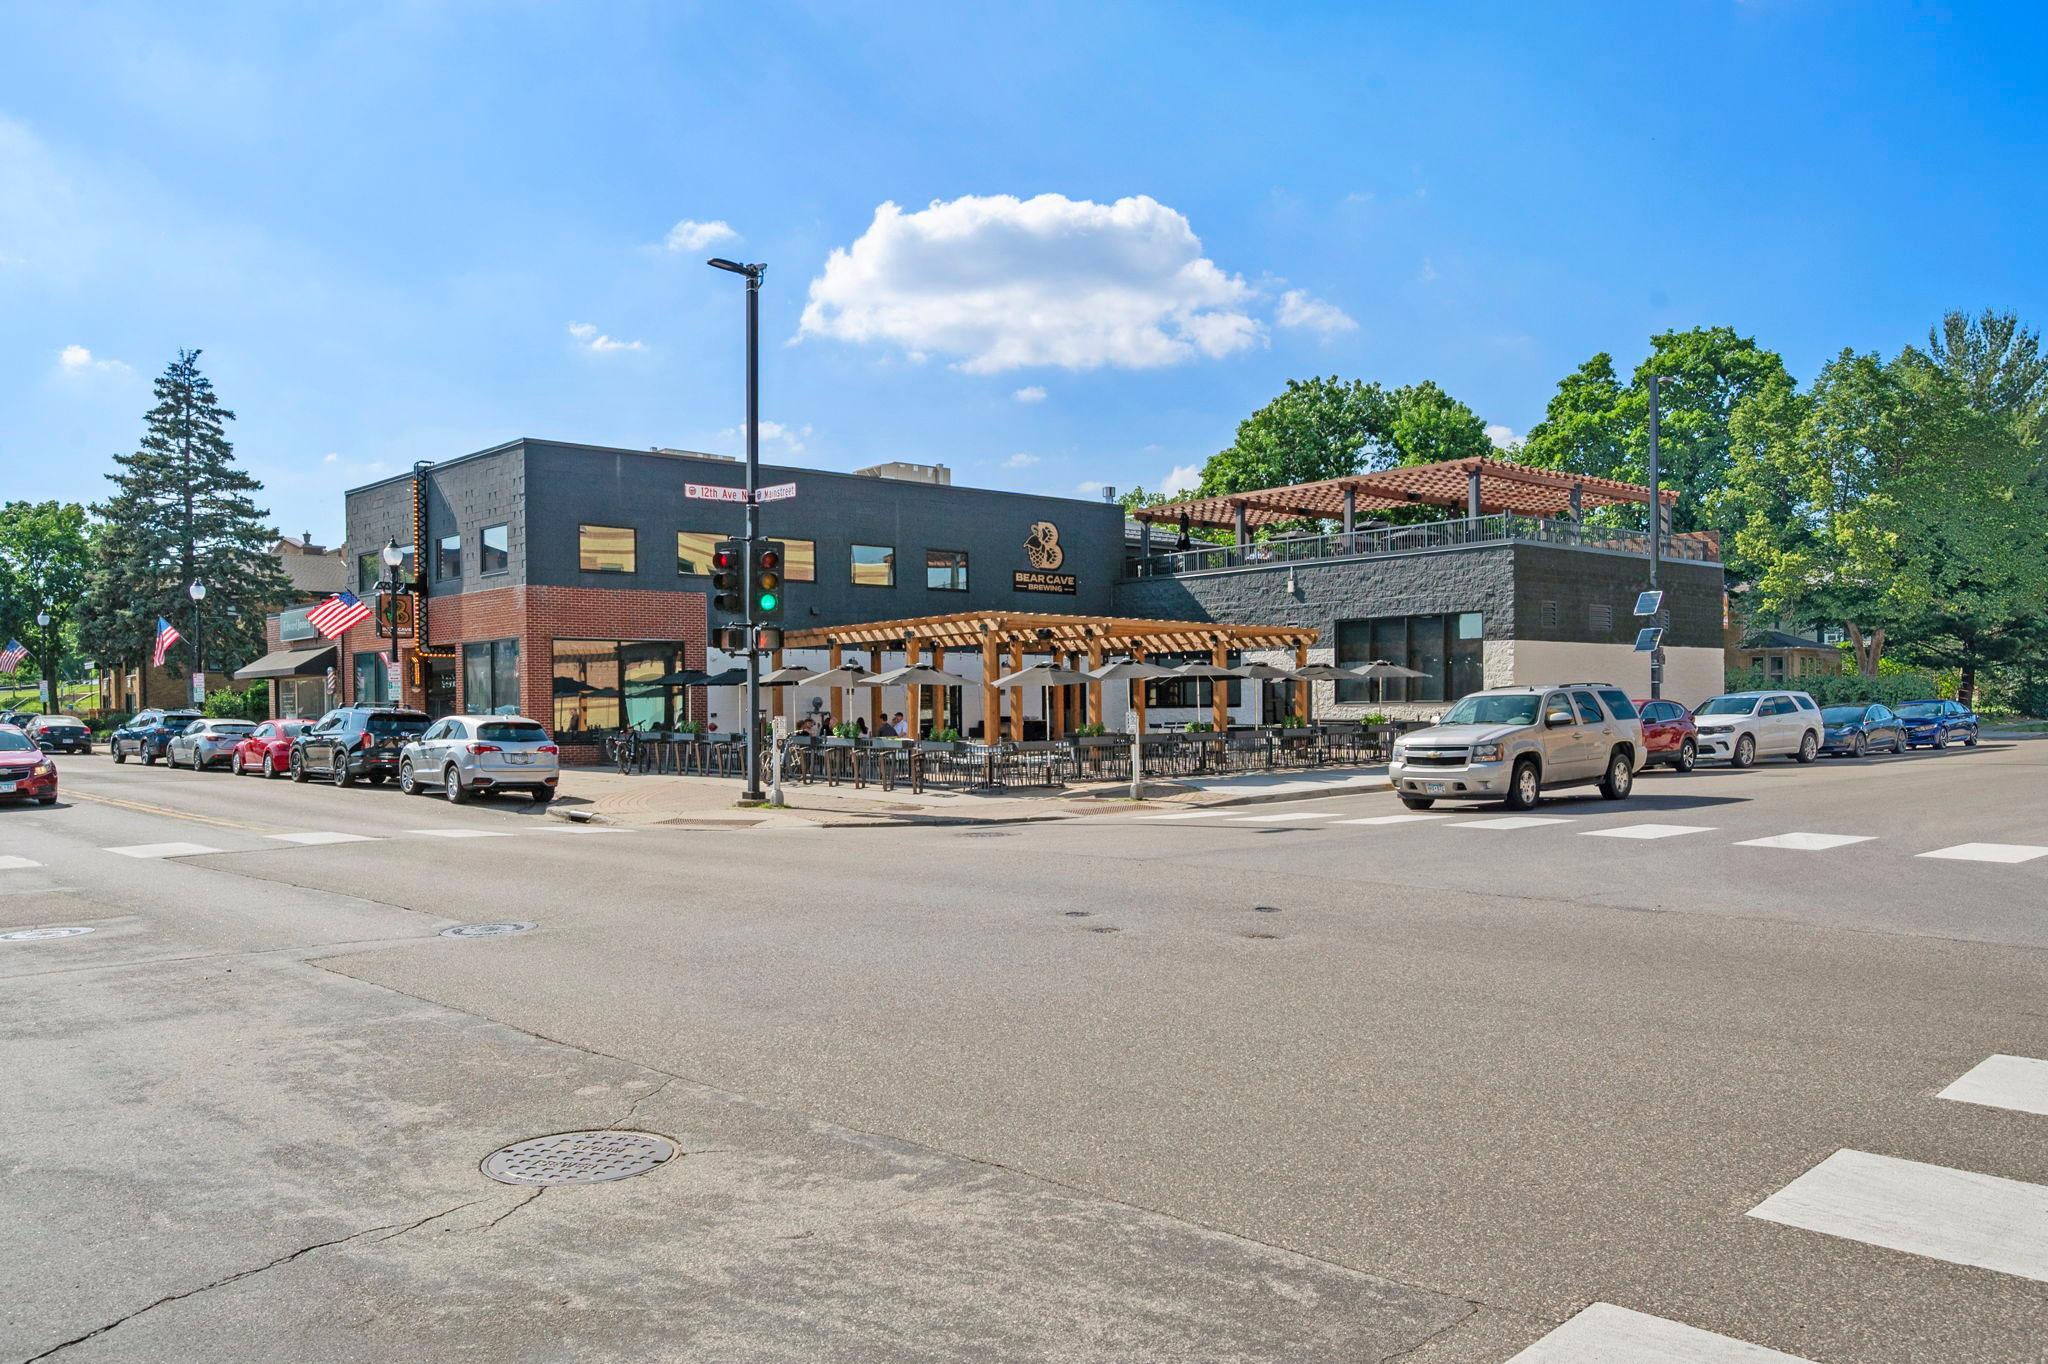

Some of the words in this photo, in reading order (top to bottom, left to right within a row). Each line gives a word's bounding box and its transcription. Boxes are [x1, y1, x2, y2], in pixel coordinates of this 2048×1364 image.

[701, 487, 718, 498] 12th
[722, 489, 737, 500] Ave
[764, 486, 795, 498] Mainstreet
[1016, 572, 1045, 583] BEAR
[1046, 575, 1075, 585] CAVE
[1028, 584, 1063, 592] BREWING
